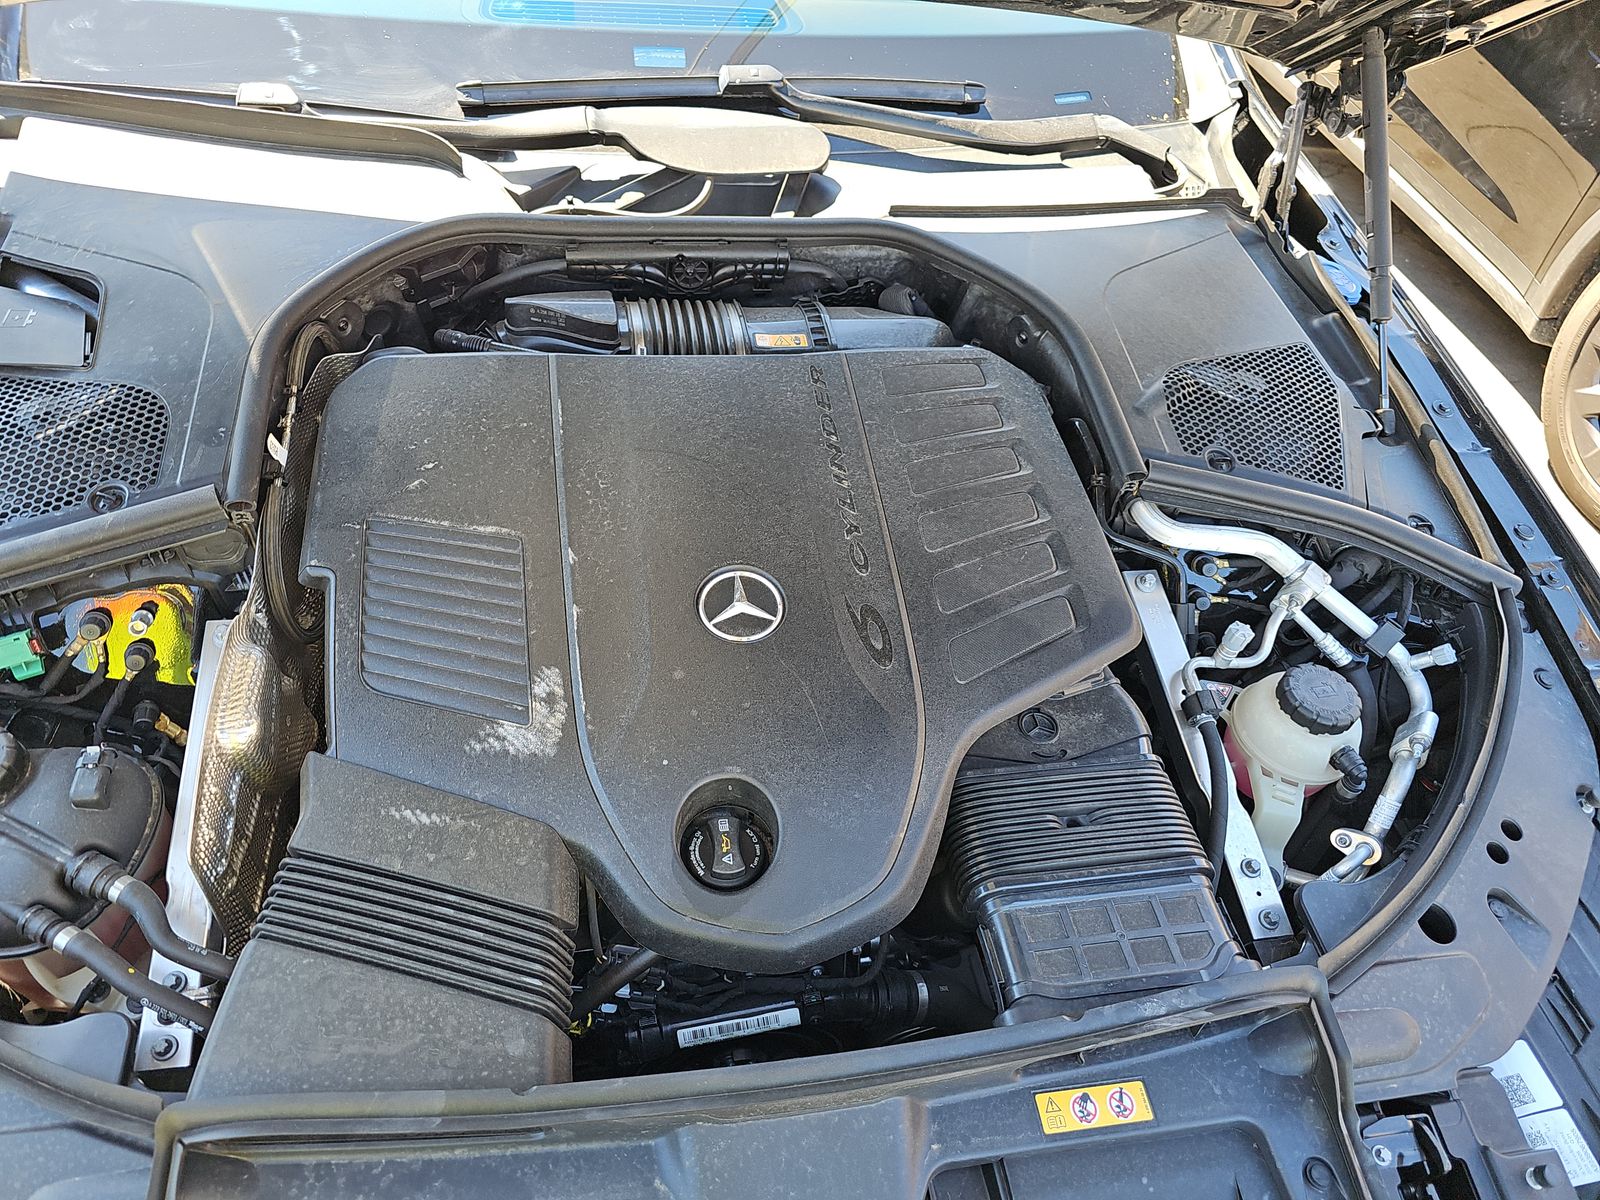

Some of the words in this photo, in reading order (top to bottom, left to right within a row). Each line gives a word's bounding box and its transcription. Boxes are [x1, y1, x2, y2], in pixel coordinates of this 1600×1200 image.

[809, 365, 870, 576] CYLINDER
[695, 835, 705, 869] recommended
[745, 828, 758, 843] CLICK
[689, 837, 705, 877] Mercedes-Benz
[750, 856, 759, 869] Turn
